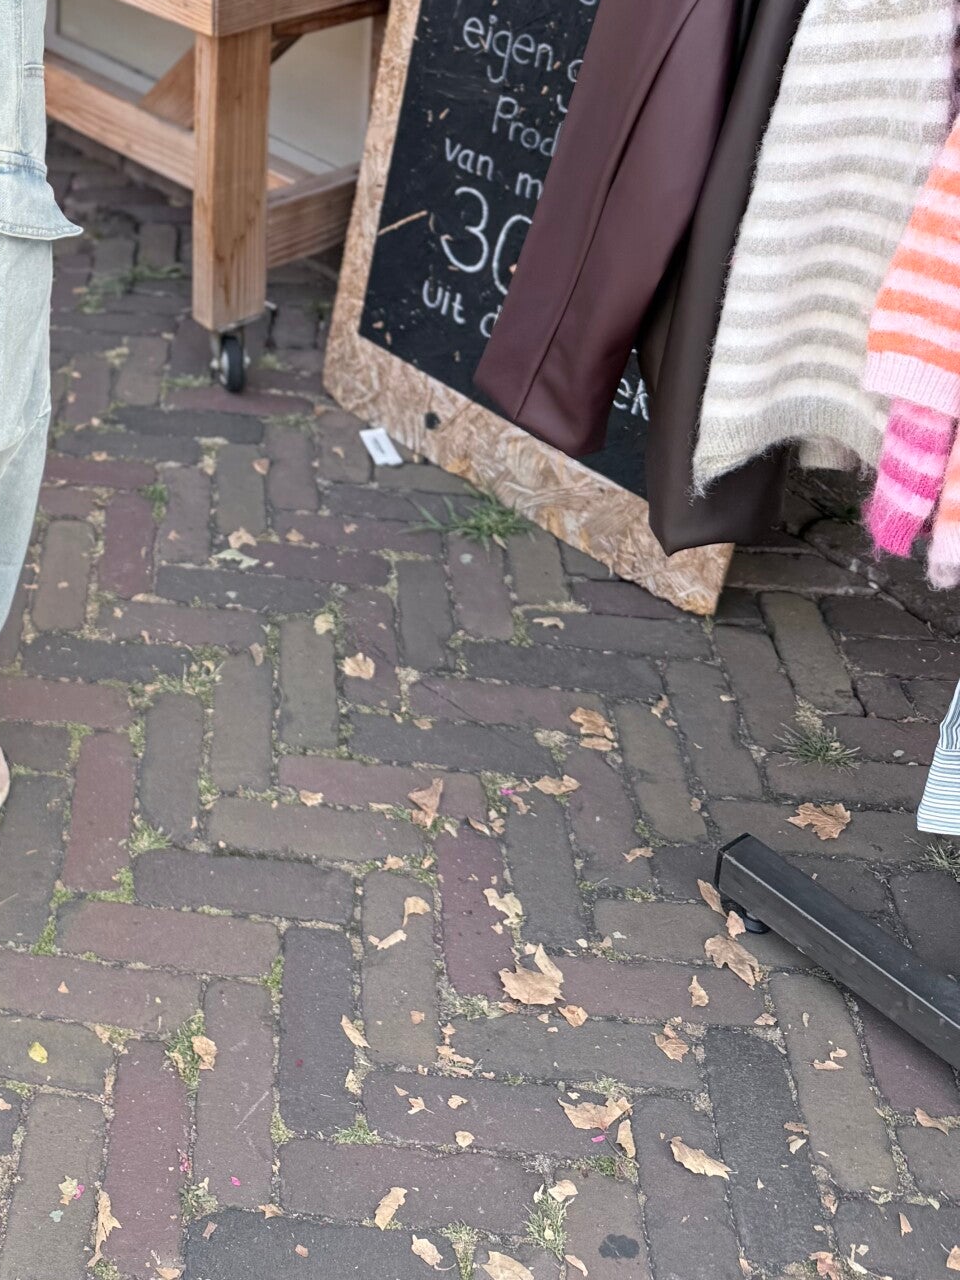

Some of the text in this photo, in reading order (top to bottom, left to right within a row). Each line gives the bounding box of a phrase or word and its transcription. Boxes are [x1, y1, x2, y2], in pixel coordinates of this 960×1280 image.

[462, 14, 554, 84] eigen
[492, 94, 562, 157] Prod
[445, 137, 544, 200] van m
[479, 304, 502, 338] d
[612, 377, 649, 421] ek
